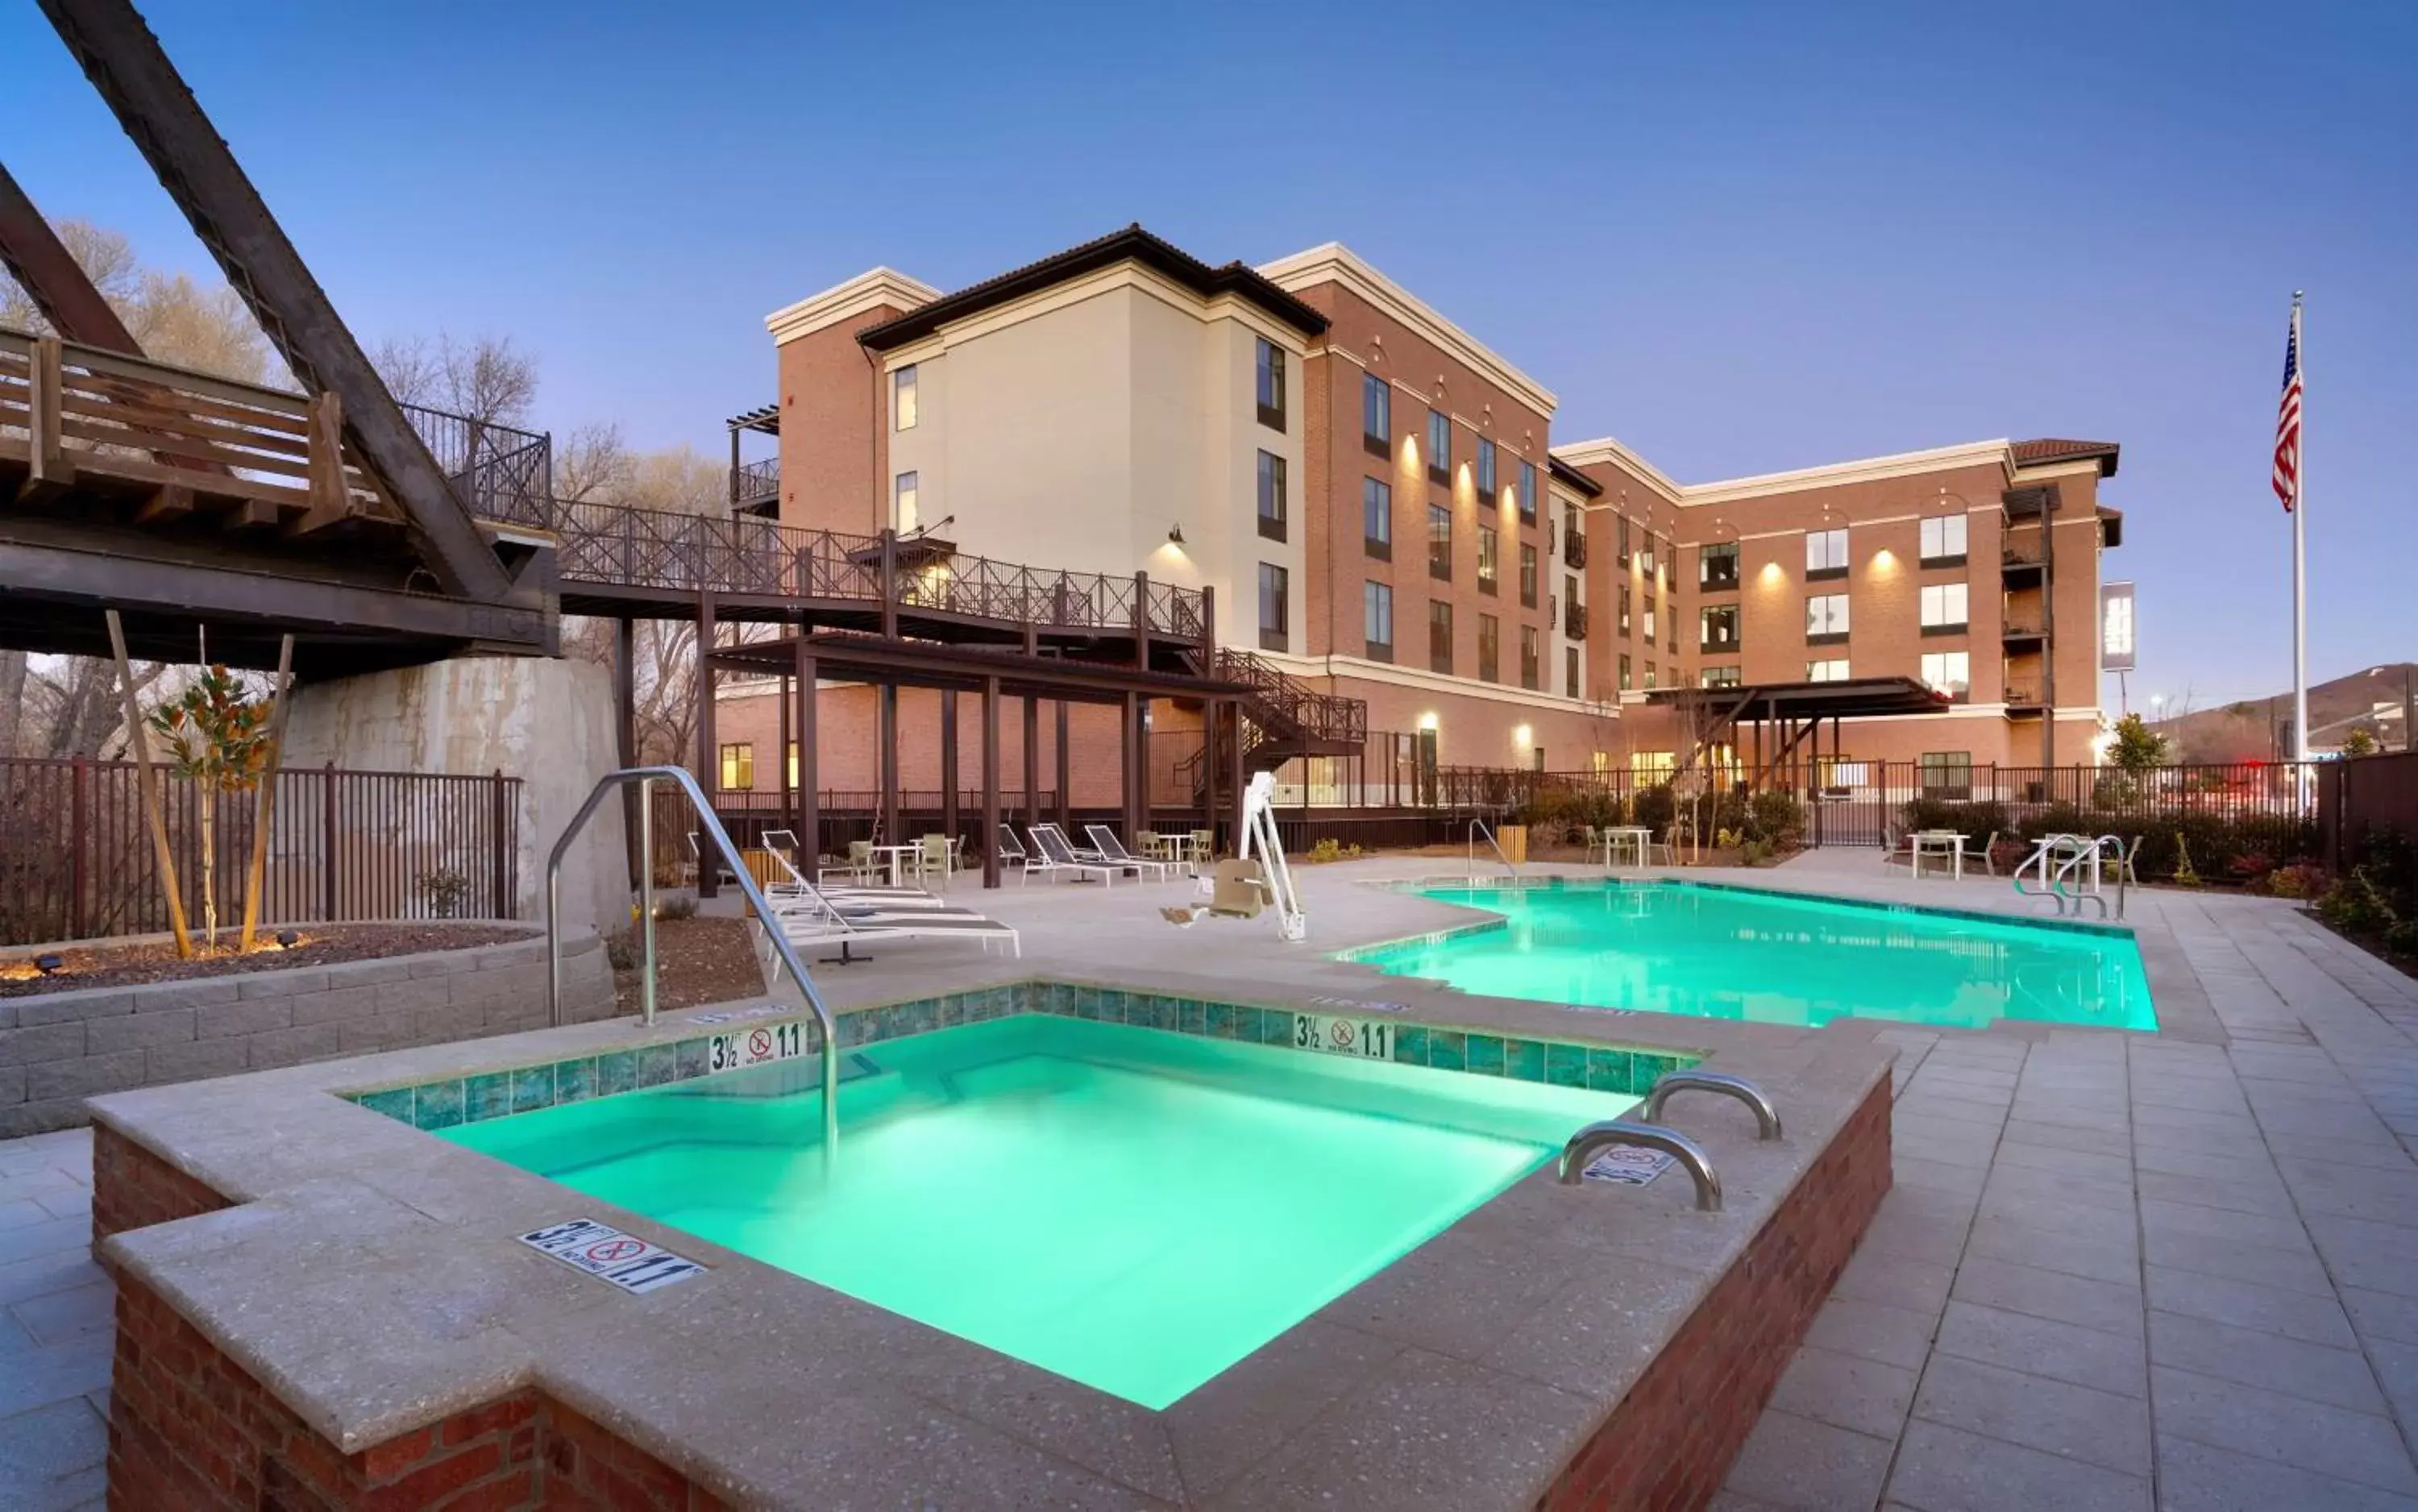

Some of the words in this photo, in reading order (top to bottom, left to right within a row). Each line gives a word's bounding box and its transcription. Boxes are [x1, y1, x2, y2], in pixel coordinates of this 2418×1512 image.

[778, 1024, 799, 1057] 1.1
[1362, 1024, 1386, 1057] 1.1
[608, 1257, 694, 1286] 1.1
